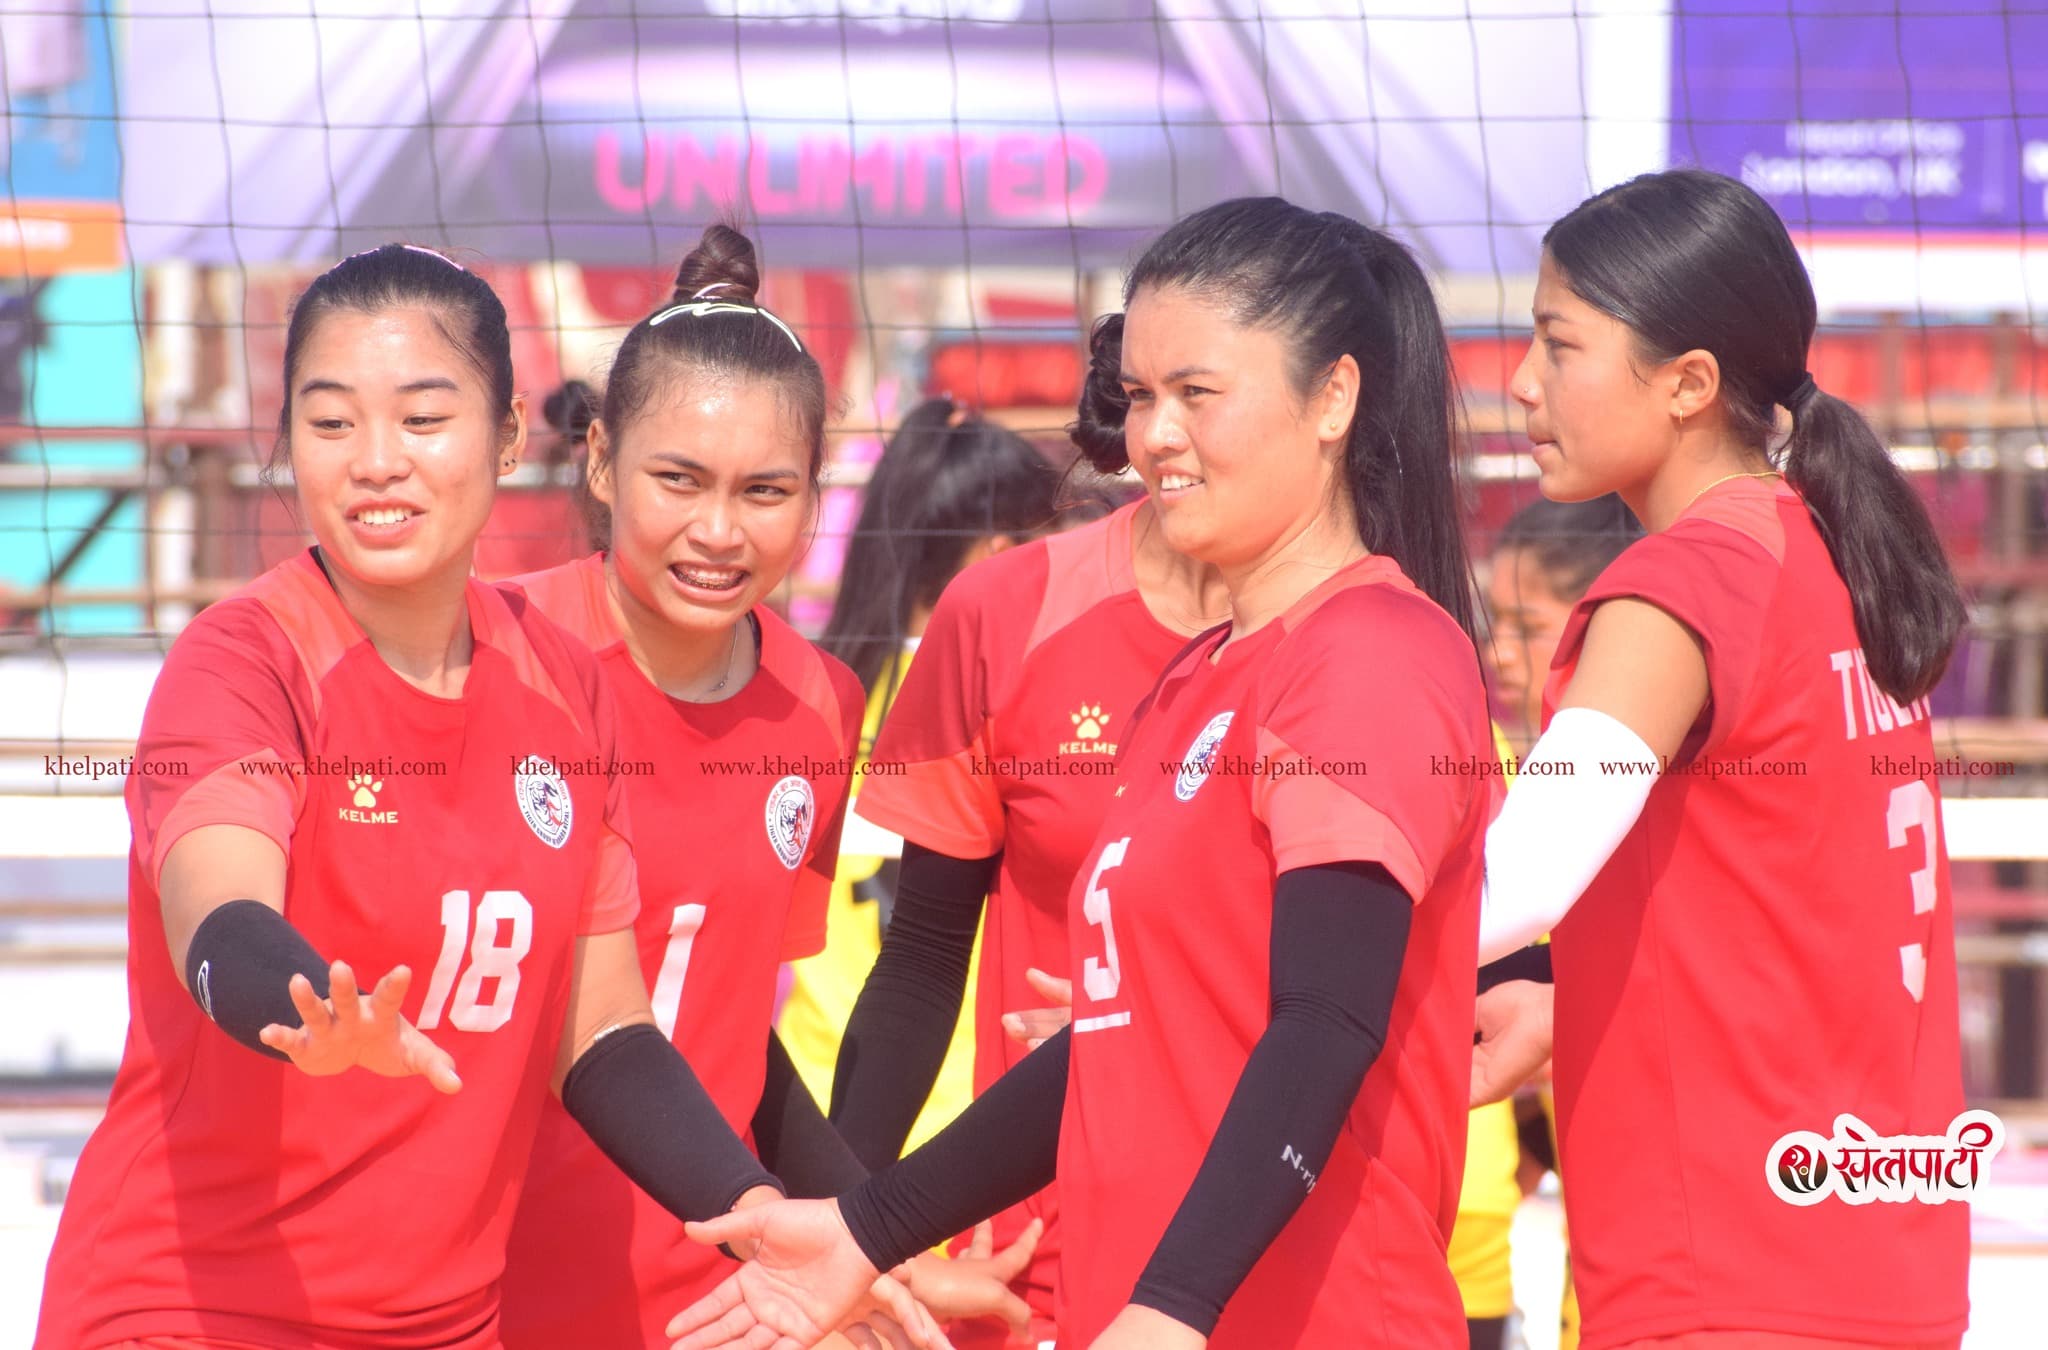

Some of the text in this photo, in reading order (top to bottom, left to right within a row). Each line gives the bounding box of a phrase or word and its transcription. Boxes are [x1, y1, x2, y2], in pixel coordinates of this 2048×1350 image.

[595, 131, 1109, 216] UNLIMITED
[1059, 741, 1118, 756] KELME
[339, 807, 399, 824] KELME
[416, 890, 533, 1033] 18
[650, 903, 706, 1042] 1
[1083, 837, 1132, 1002] 5
